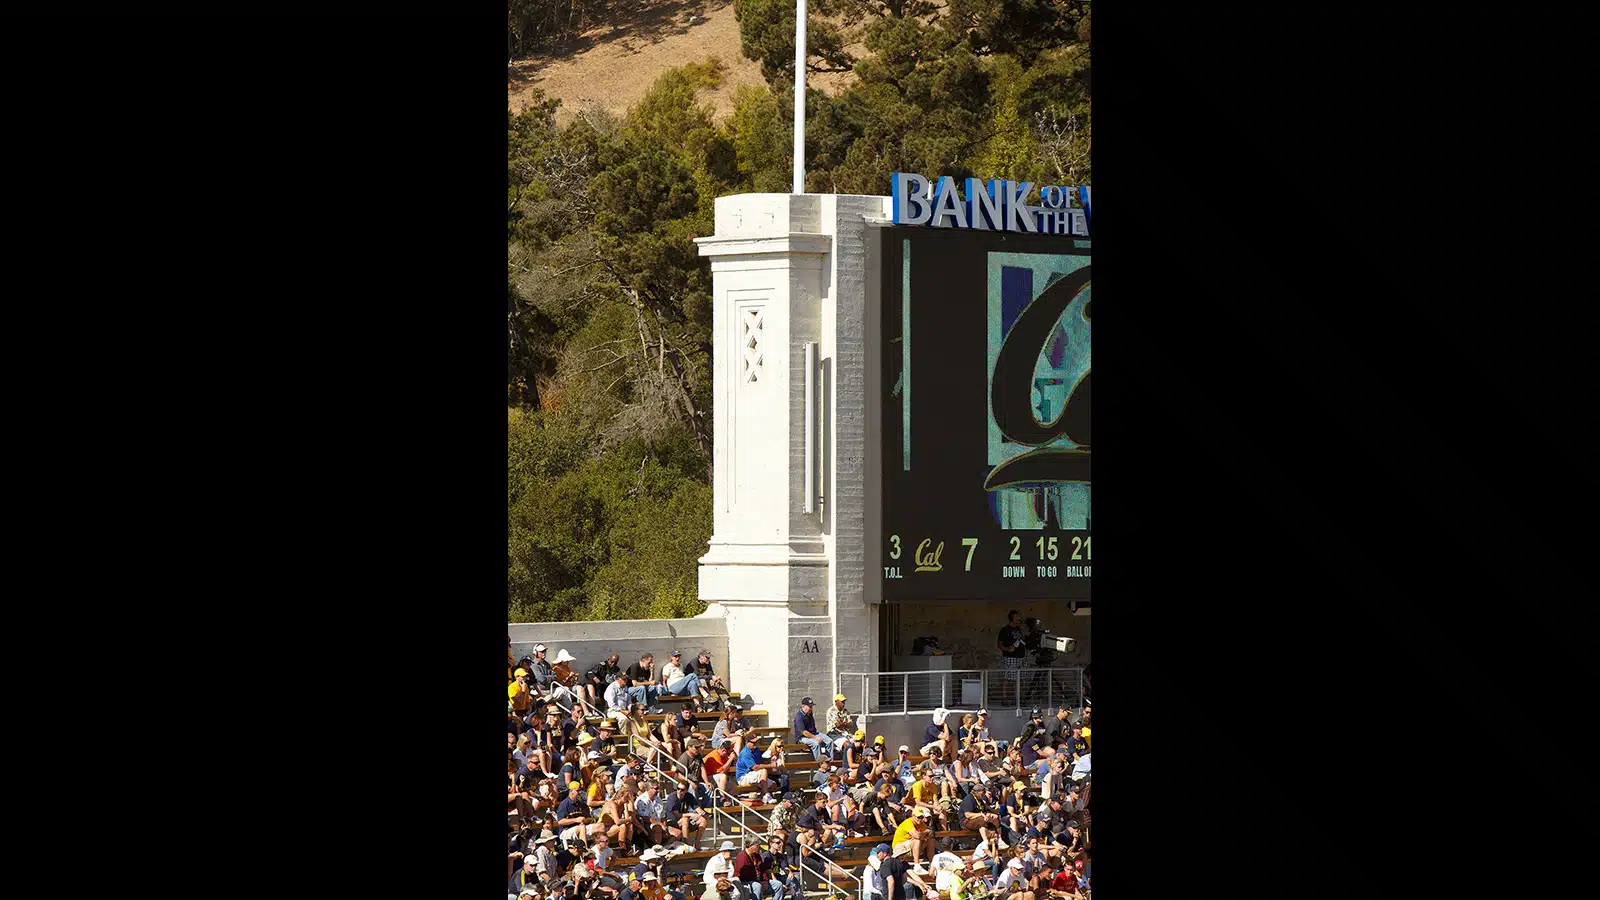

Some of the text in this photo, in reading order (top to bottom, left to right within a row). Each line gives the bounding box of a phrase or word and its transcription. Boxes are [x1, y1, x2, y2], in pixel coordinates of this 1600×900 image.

[892, 171, 1038, 233] BANK
[1043, 185, 1080, 209] OF
[1036, 211, 1089, 236] THE
[889, 534, 902, 560] 3
[914, 538, 945, 573] Cal
[961, 537, 979, 572] 7
[1009, 536, 1021, 560] 2
[1036, 536, 1059, 560] 15
[1071, 536, 1091, 560] 21
[1002, 565, 1025, 578] DOWN
[1036, 565, 1057, 578] TO GO
[1066, 565, 1083, 578] BALL
[802, 640, 820, 654] AA
